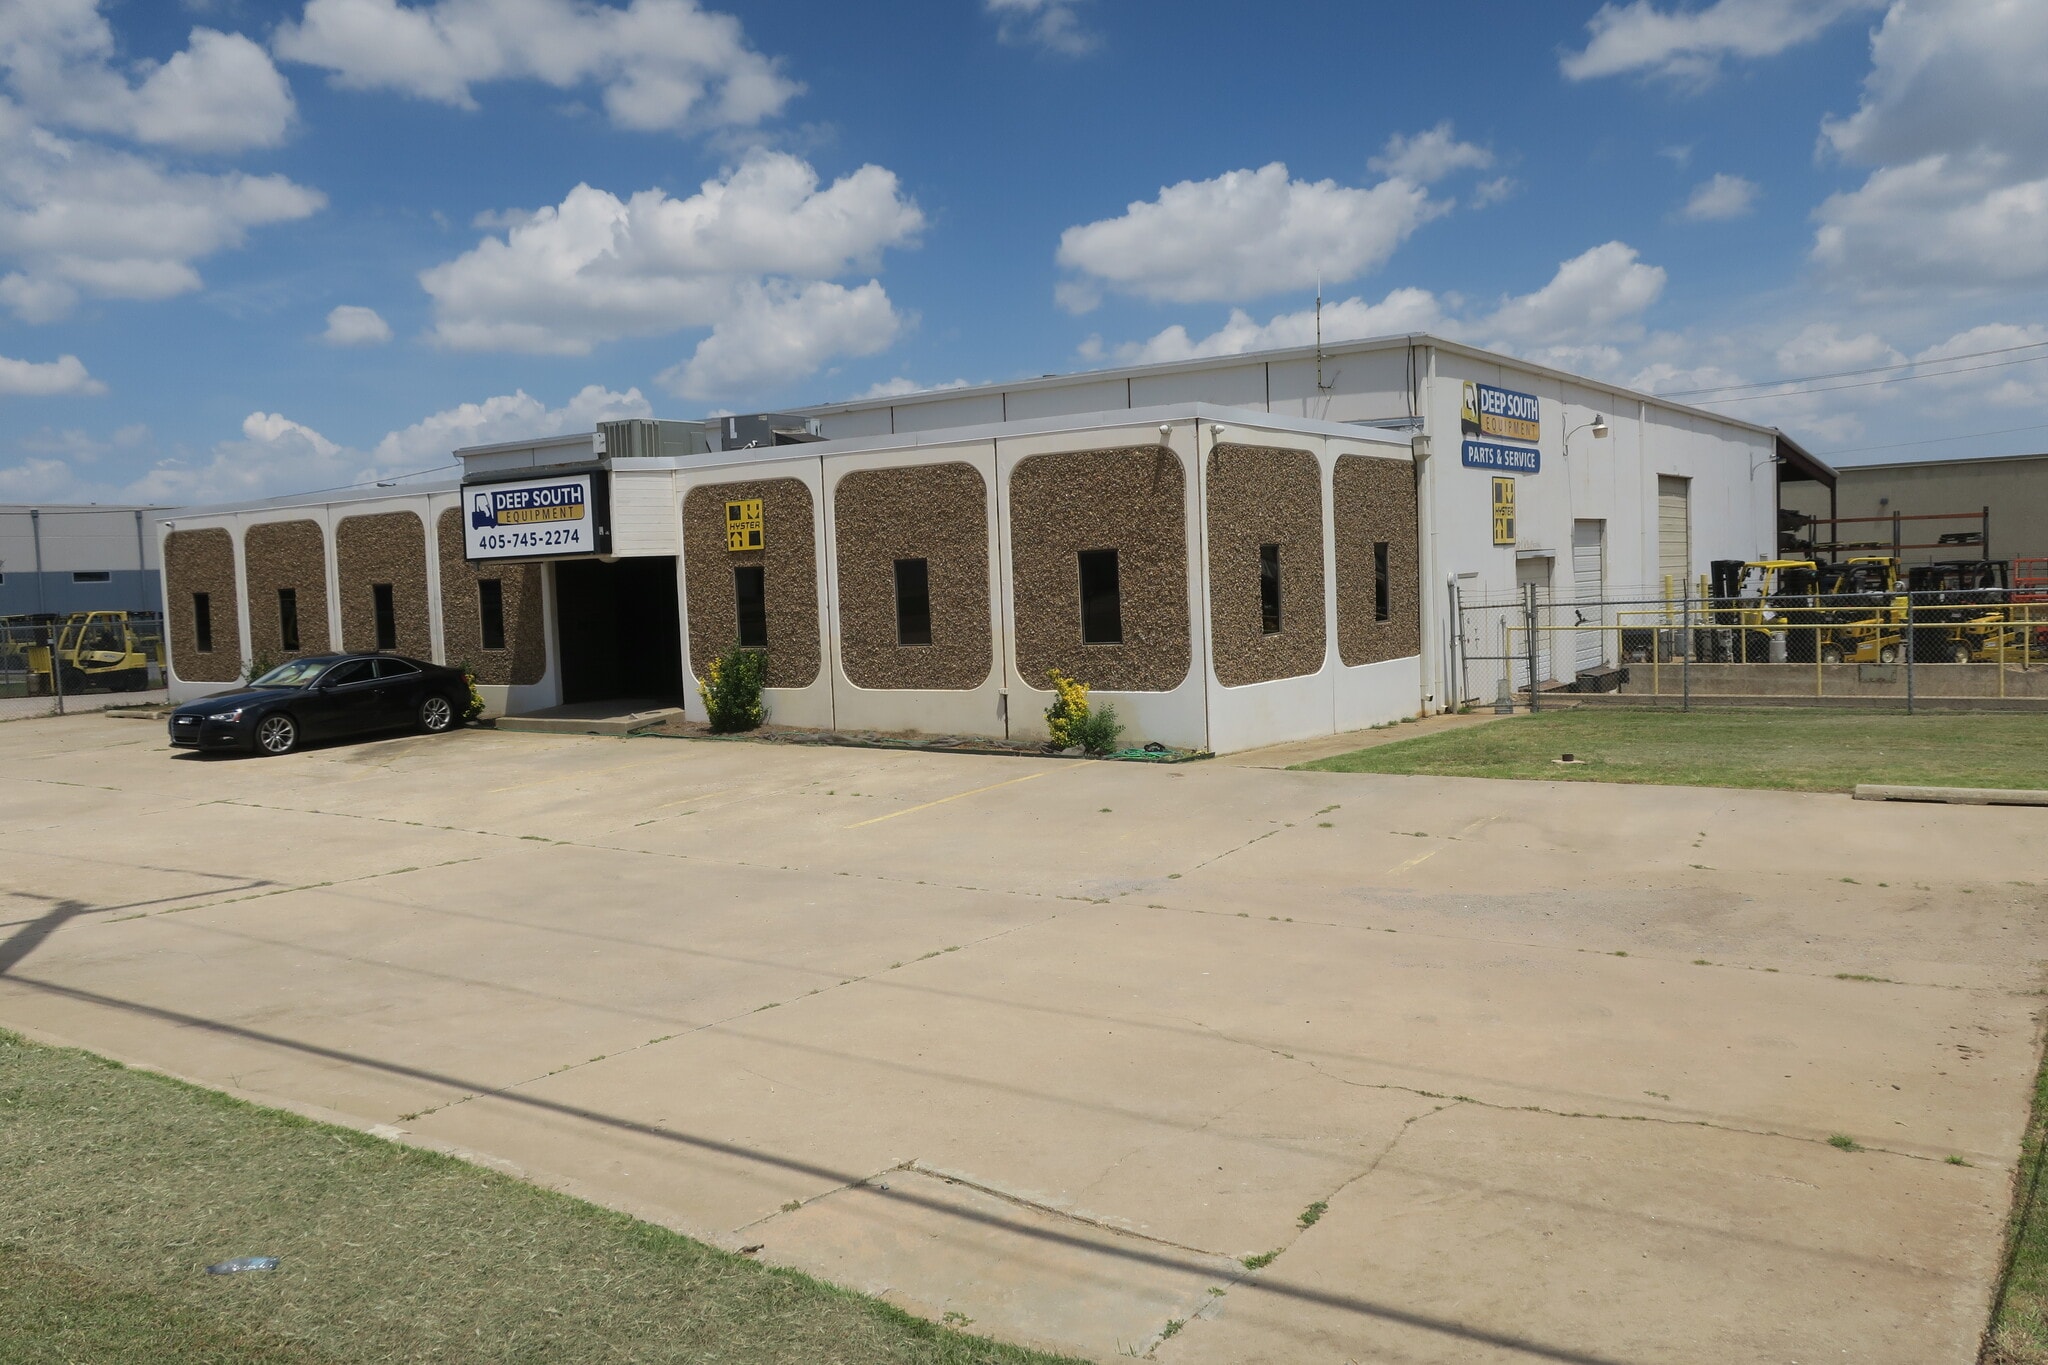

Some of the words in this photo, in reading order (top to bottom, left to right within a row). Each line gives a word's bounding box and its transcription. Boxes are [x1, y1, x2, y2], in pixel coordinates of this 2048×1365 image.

[1481, 388, 1506, 414] DEEP
[1508, 394, 1538, 420] SOUTH
[1486, 416, 1536, 436] EQUIPMENT
[1468, 445, 1494, 464] PARTS
[1496, 449, 1503, 465] &
[1504, 450, 1536, 468] SERVICE
[497, 491, 529, 509] DEEP
[533, 486, 582, 506] SOUTH
[506, 506, 574, 523] EQUIPMENT
[730, 521, 760, 530] HYSTER
[479, 529, 580, 550] 405-745-2274
